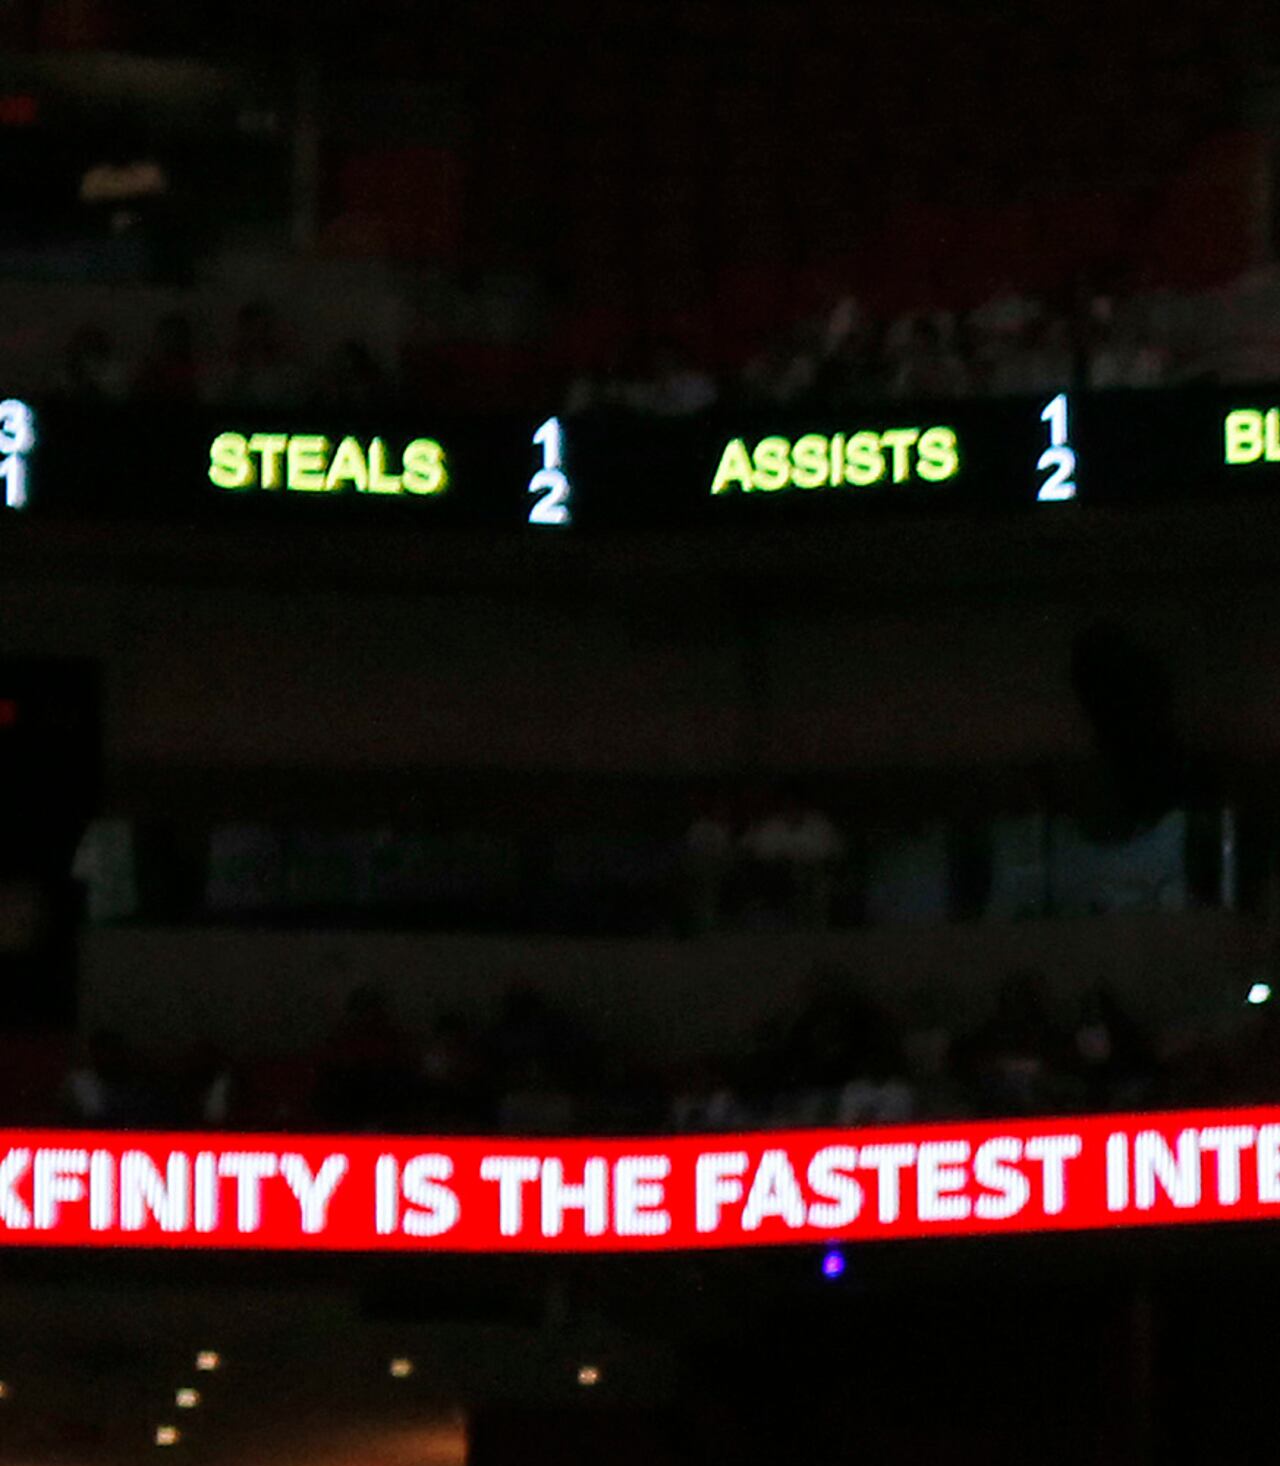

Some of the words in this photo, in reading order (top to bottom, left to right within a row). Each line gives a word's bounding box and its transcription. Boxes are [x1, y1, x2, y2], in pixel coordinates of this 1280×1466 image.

[532, 417, 563, 468] 1
[1039, 394, 1069, 446] 1
[208, 432, 448, 494] STEALS
[711, 426, 959, 494] ASSISTS
[1036, 446, 1076, 501] 2
[528, 467, 570, 525] 2
[375, 1153, 460, 1237] IS
[479, 1155, 672, 1237] THE
[695, 1135, 1082, 1233] FASTEST
